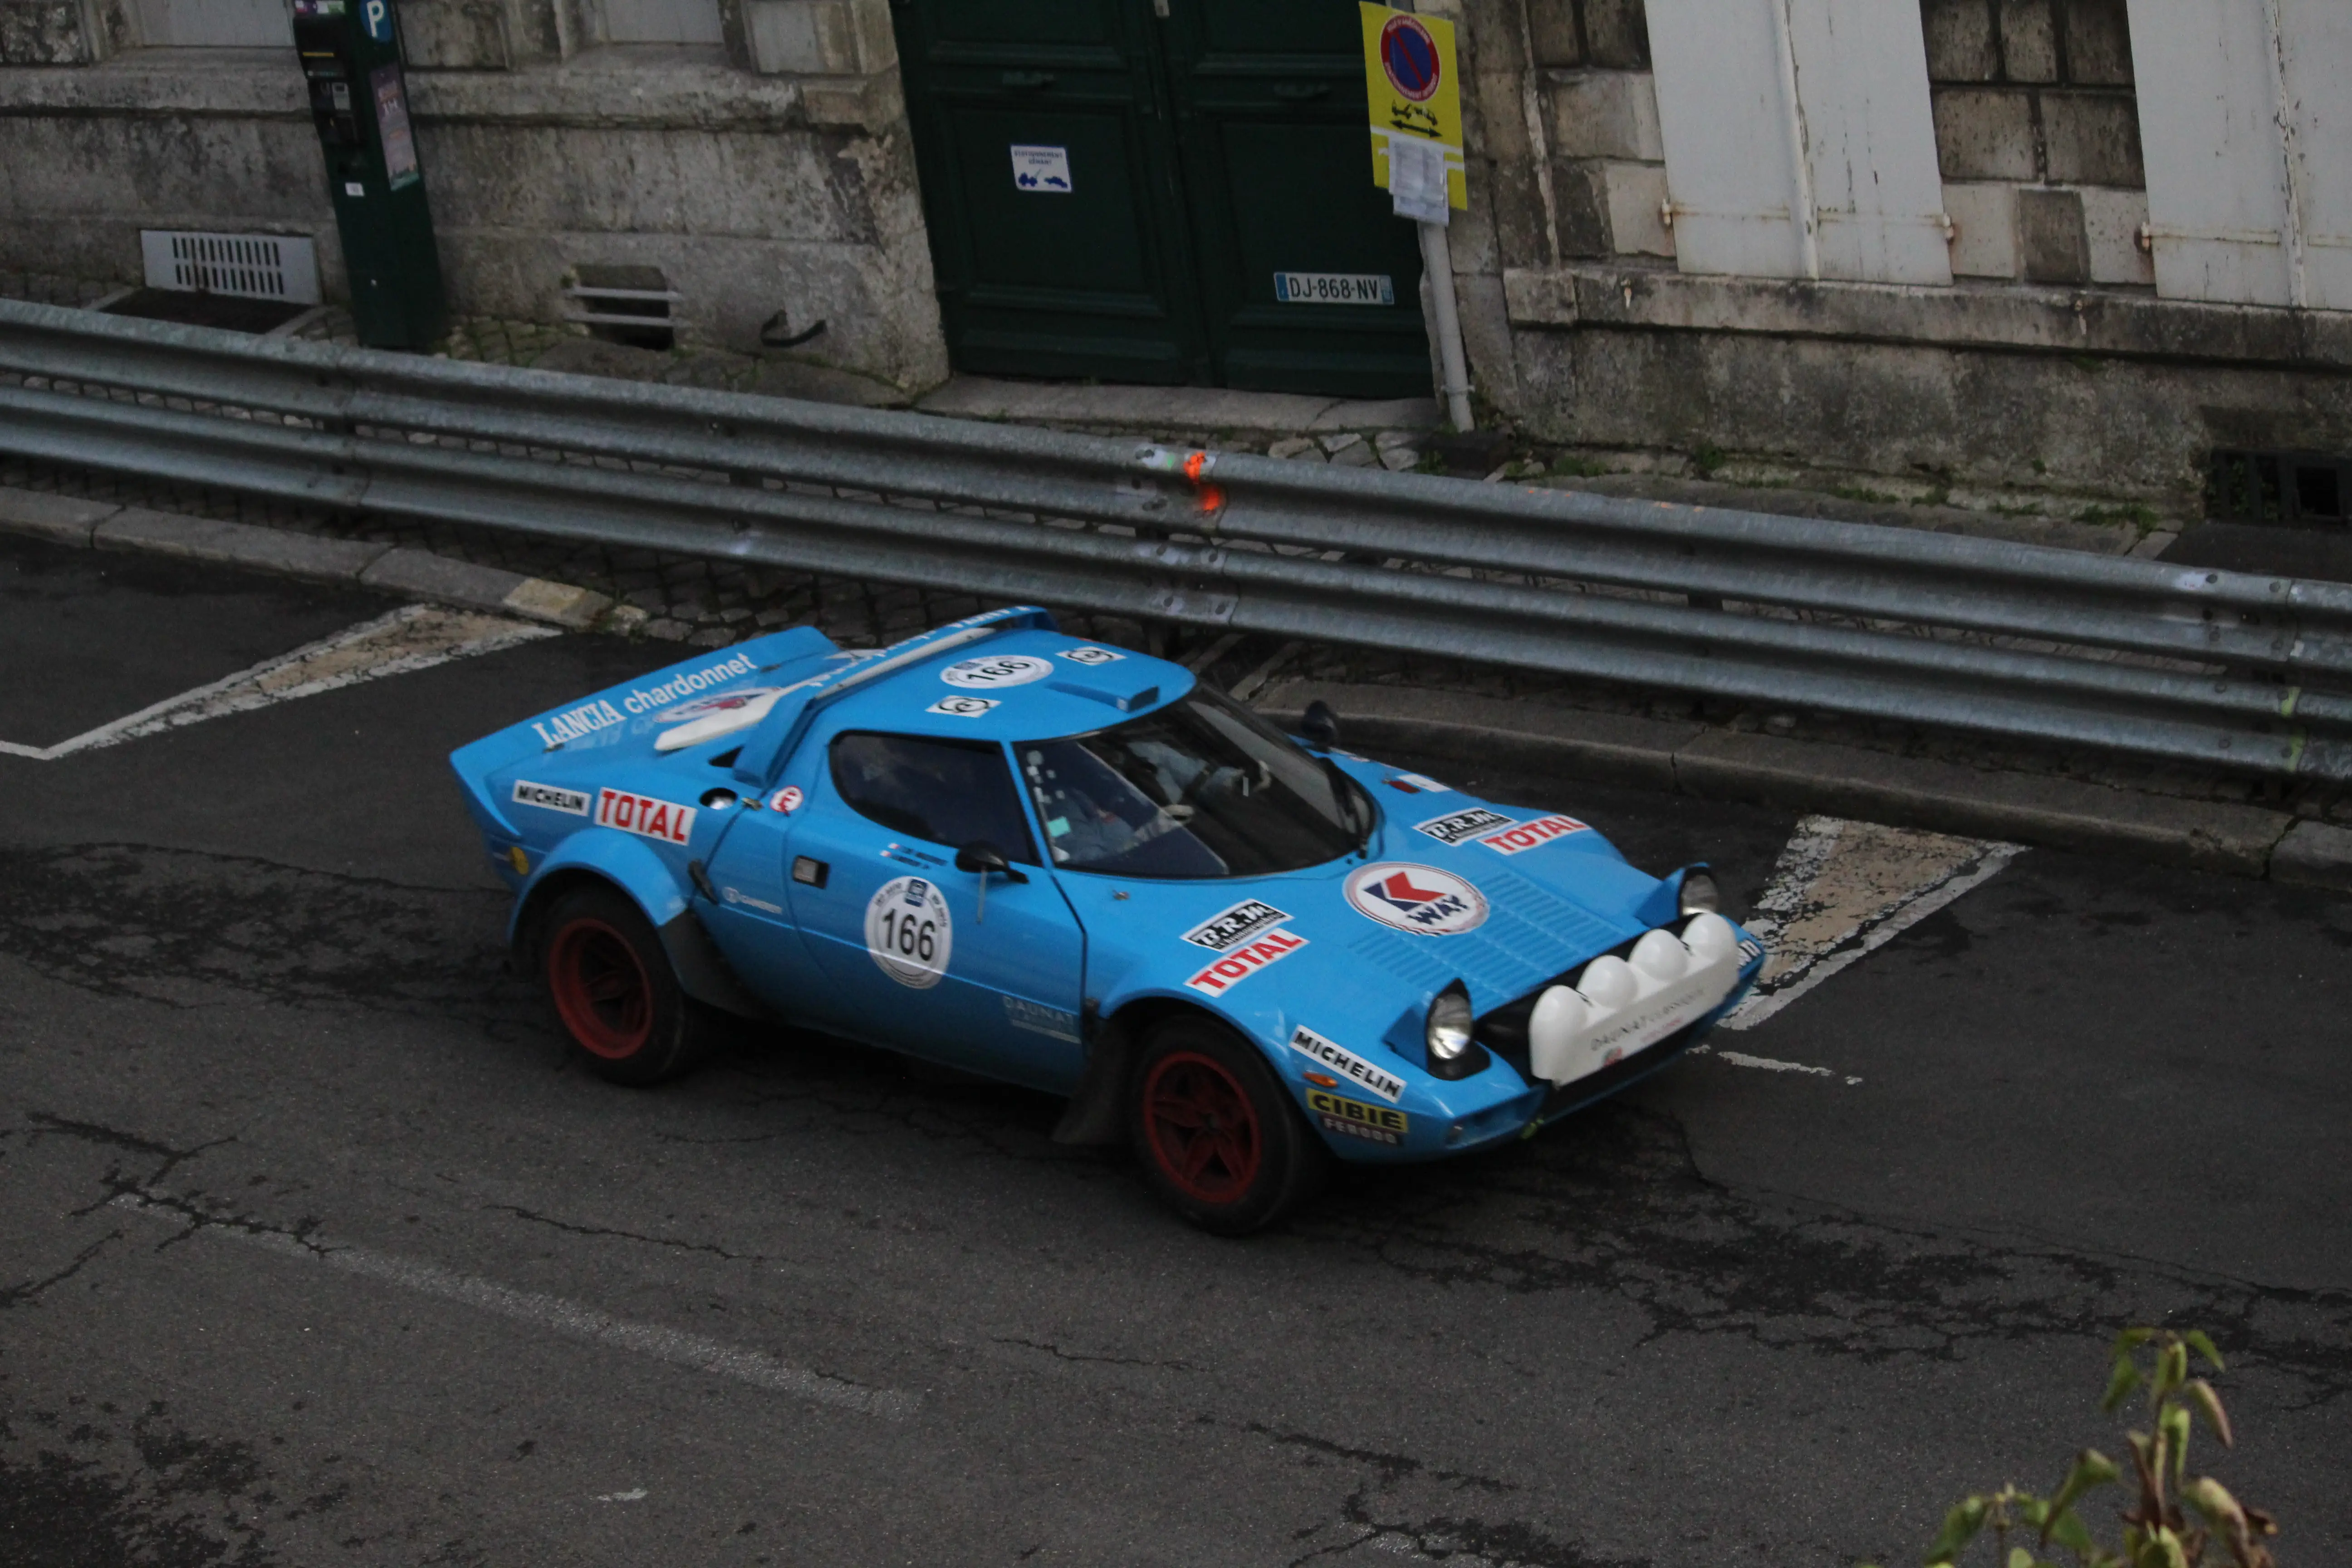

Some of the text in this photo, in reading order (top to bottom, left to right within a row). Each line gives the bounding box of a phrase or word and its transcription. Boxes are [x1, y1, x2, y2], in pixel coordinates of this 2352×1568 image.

[367, 0, 385, 38] P
[1289, 278, 1378, 299] DJ-868-NV
[966, 660, 1030, 681] 166
[532, 700, 627, 747] LANCIA
[624, 652, 758, 714] chardonnet
[518, 785, 585, 811] MICHELIN
[601, 790, 687, 842] TOTAL
[1484, 815, 1590, 851] TOTAL
[1406, 894, 1469, 926] WAY
[882, 908, 936, 961] 166
[1193, 933, 1302, 990] TOTAL
[1294, 1031, 1402, 1098] MICHELIN
[1313, 1094, 1404, 1130] CIBIE
